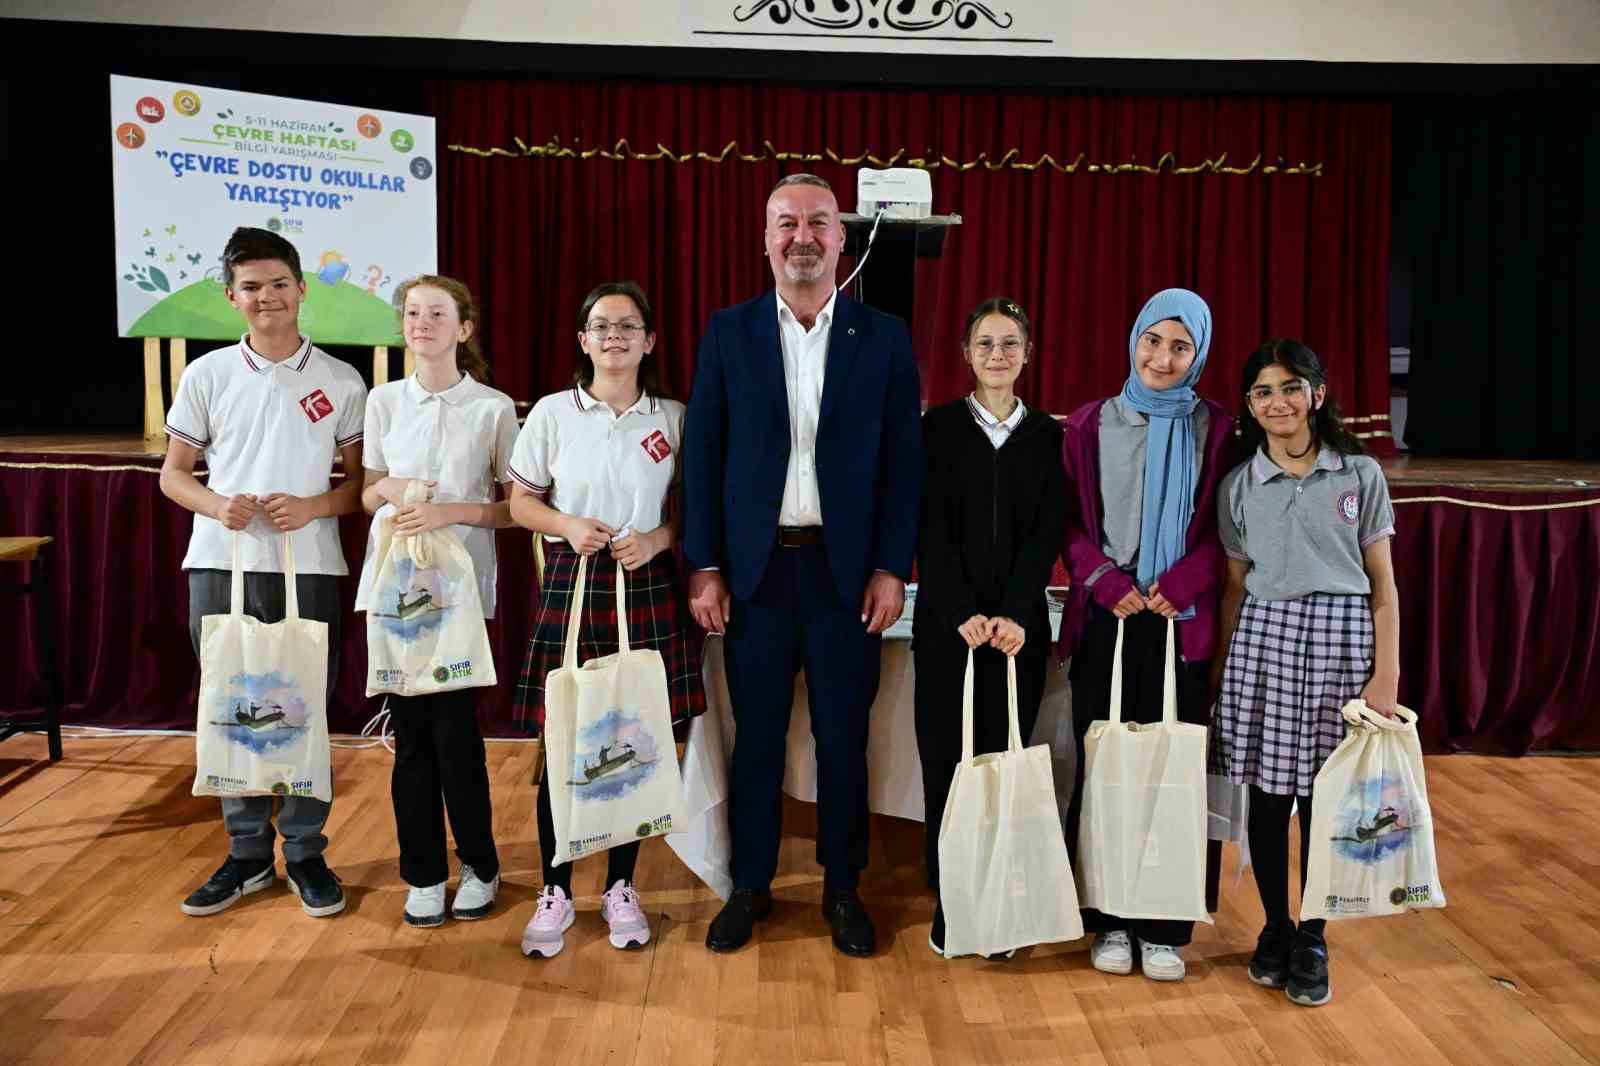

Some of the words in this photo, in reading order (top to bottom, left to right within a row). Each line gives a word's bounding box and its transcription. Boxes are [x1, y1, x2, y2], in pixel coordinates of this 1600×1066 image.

[245, 115, 266, 126] 5-11
[271, 119, 326, 132] HAZİRAN
[212, 124, 273, 141] ÇEVRE
[281, 131, 356, 151] HAFTASI
[235, 141, 268, 153] BİLGİ
[271, 146, 337, 160] YARIŞMASI
[248, 160, 312, 182] DOSTU
[321, 168, 405, 192] OKULLAR
[449, 660, 471, 672] SIFIR
[452, 669, 472, 680] ATIK
[291, 780, 313, 789] SIFIR
[1407, 884, 1429, 895] SIFIR
